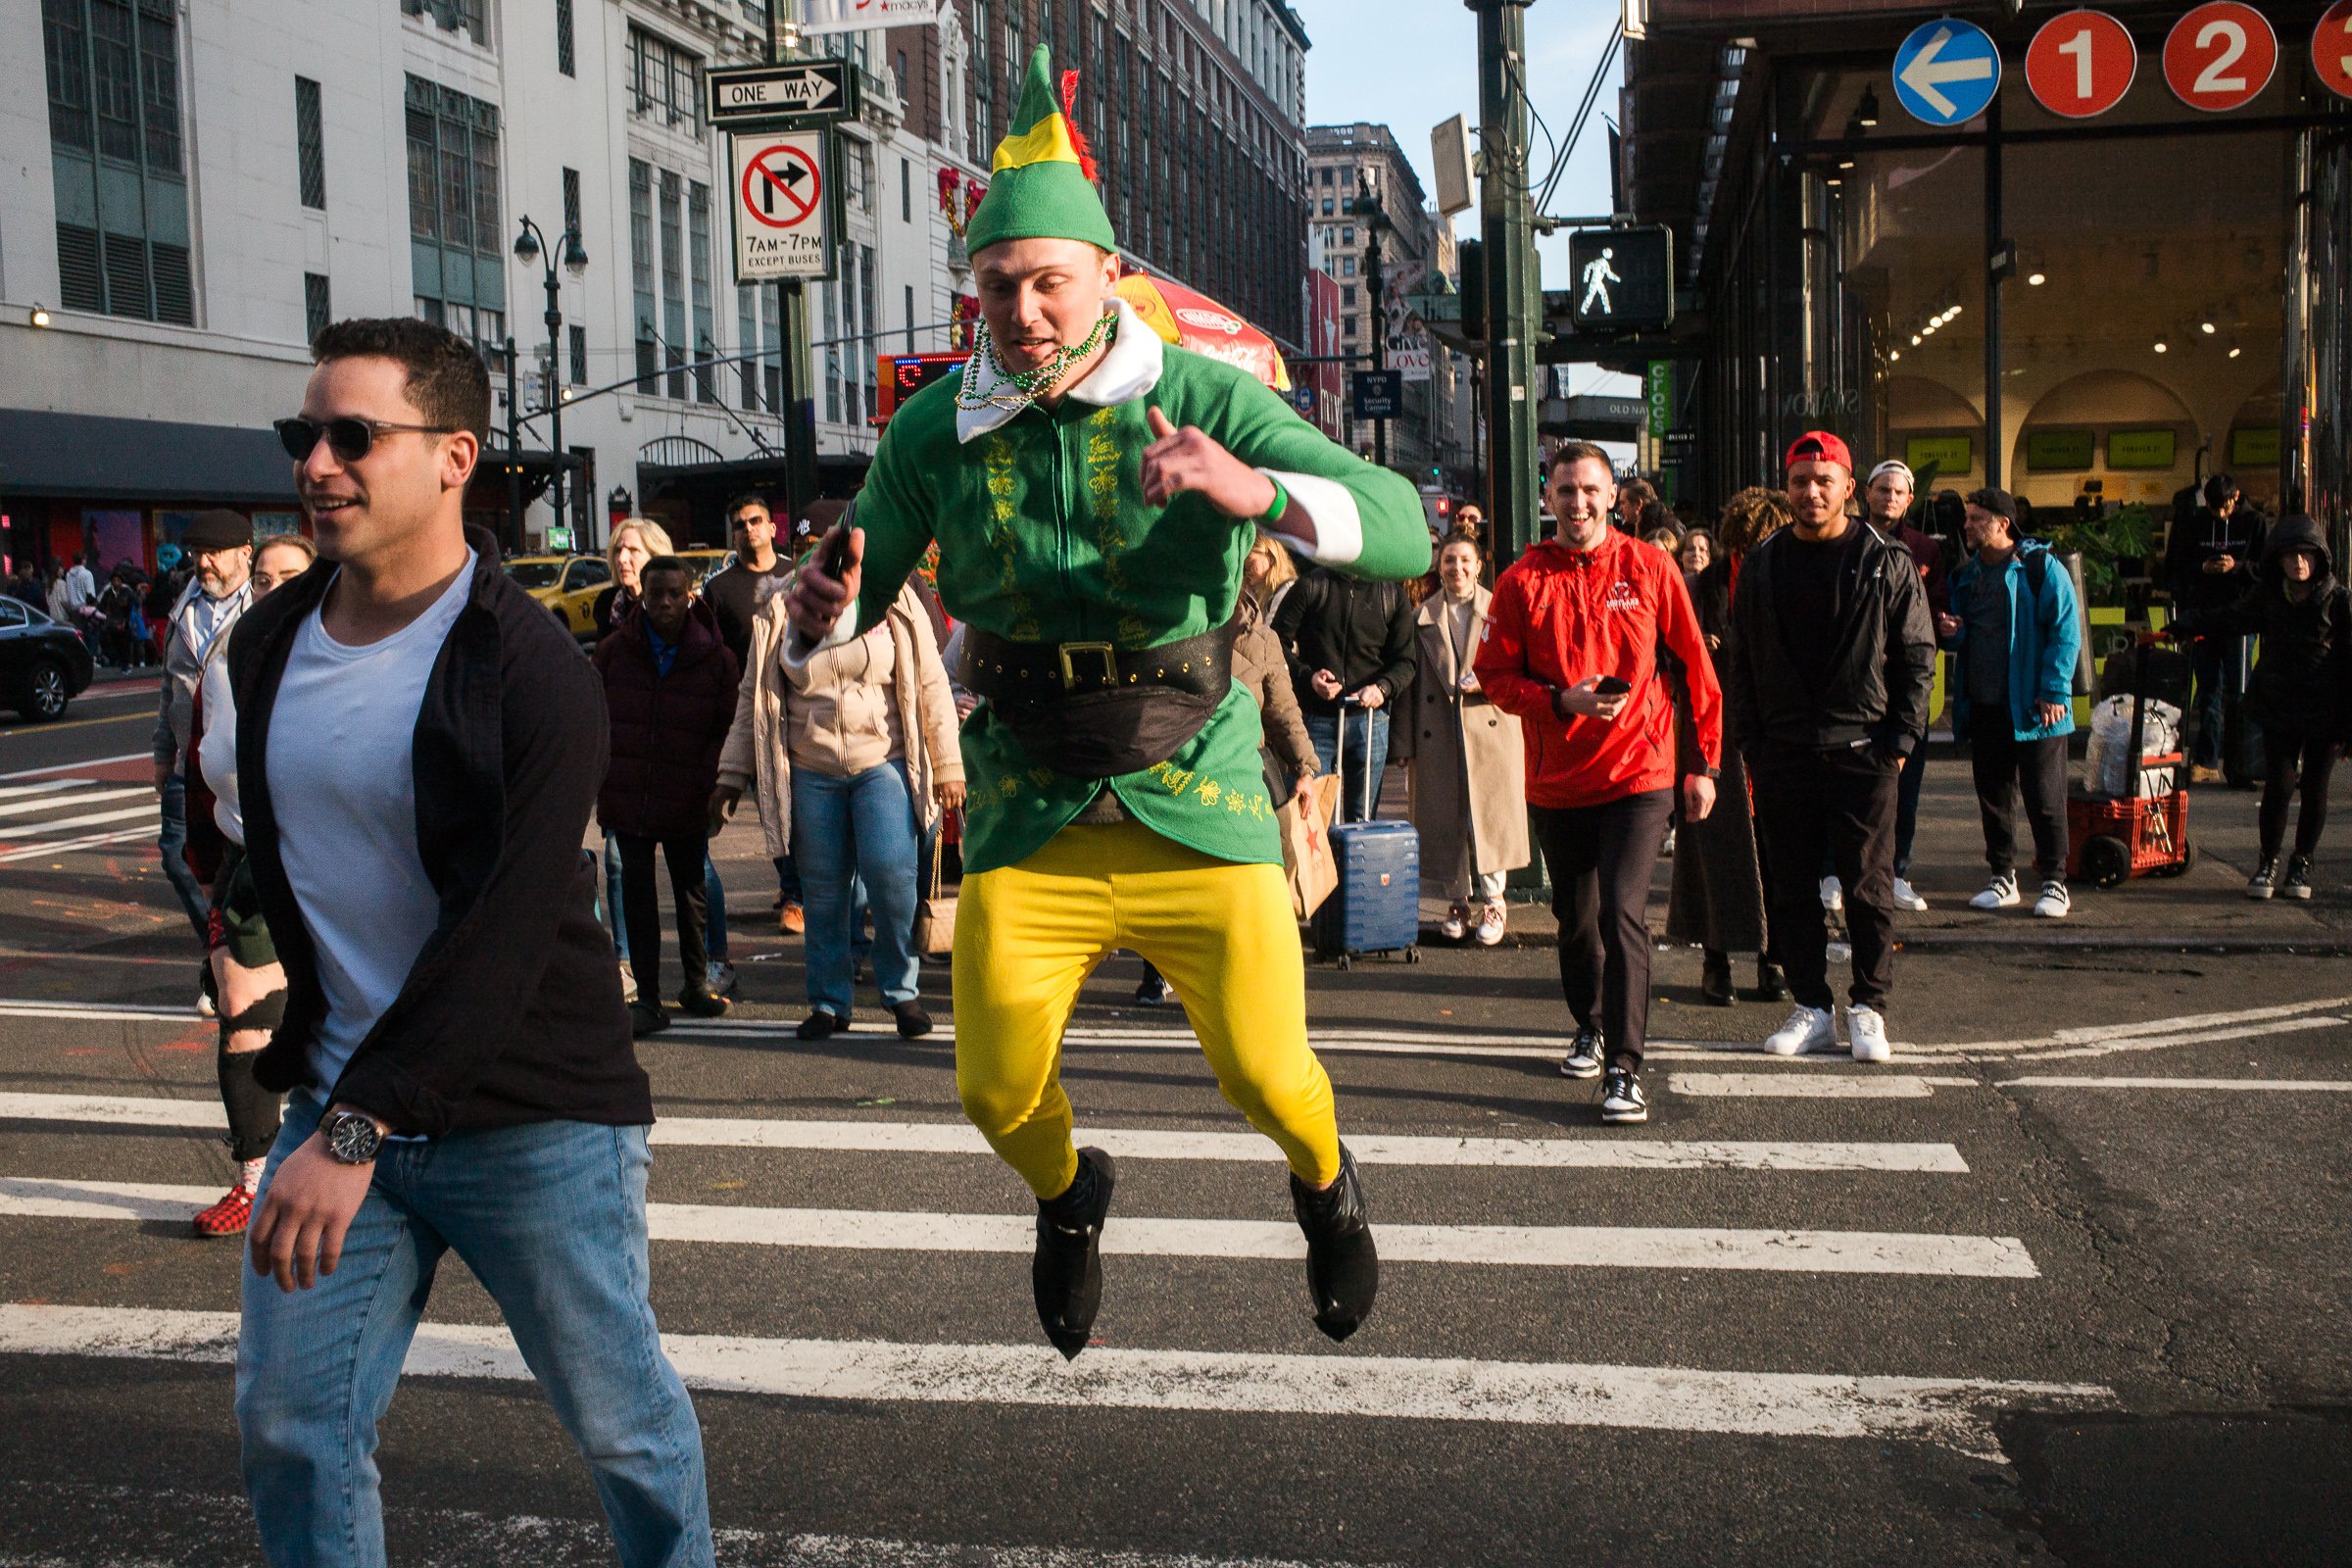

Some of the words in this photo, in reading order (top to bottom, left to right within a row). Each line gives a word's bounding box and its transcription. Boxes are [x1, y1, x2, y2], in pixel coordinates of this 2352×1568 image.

[2059, 29, 2092, 99] 1
[2192, 20, 2246, 93] 2
[732, 85, 766, 104] ONE
[784, 79, 822, 99] WAY
[746, 233, 822, 253] 7AM-7PM
[748, 256, 784, 268] EXCEPT
[788, 254, 821, 266] BUSES
[1609, 404, 1630, 415] OLD
